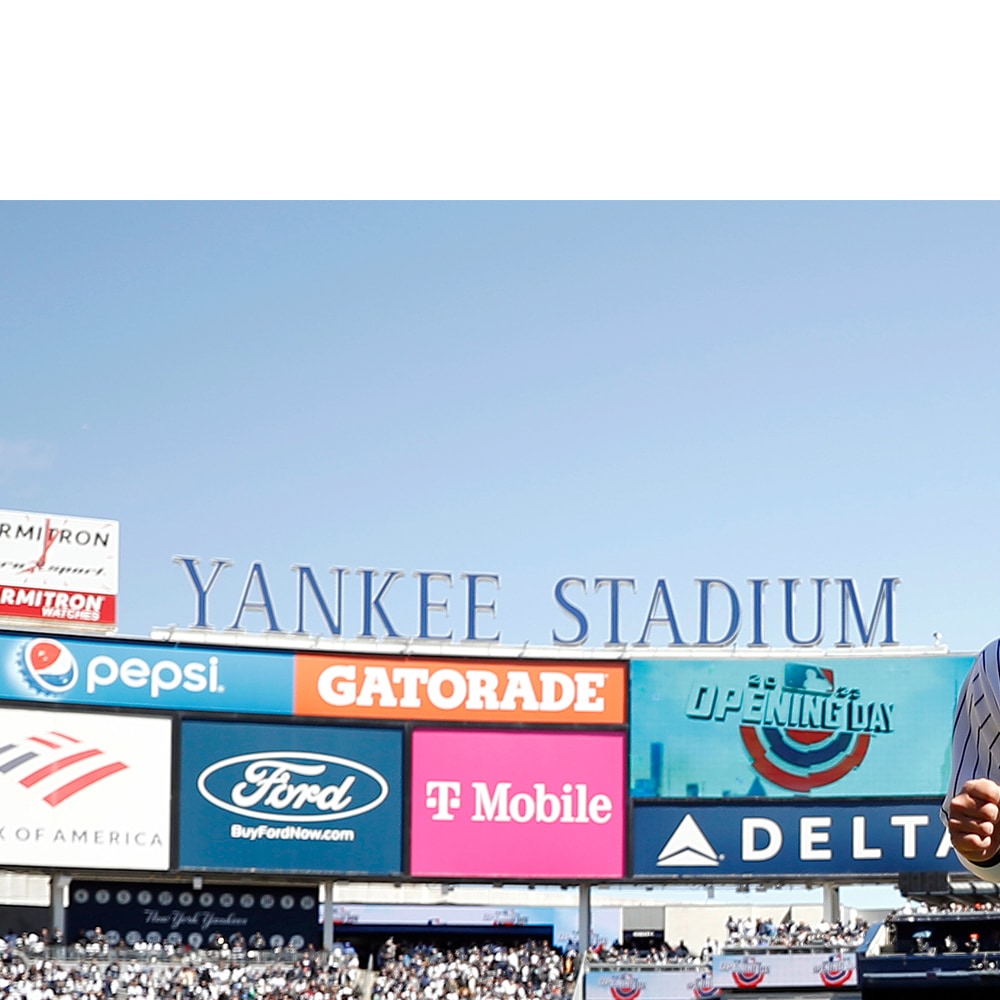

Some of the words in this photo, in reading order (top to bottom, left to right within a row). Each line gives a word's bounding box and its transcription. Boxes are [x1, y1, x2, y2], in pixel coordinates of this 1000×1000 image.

[42, 606, 100, 622] WATCHES
[172, 555, 501, 641] YANKEE
[551, 575, 902, 649] STADIUM
[87, 656, 222, 697] pepsi
[317, 665, 606, 713] GATORADE
[686, 682, 845, 729] OPENING
[847, 702, 895, 733] DAY
[231, 760, 356, 811] Ford
[426, 782, 461, 822] T
[471, 782, 613, 823] Mobile
[15, 827, 45, 841] OF
[53, 828, 163, 846] AMERICA
[230, 824, 355, 841] BuyFordNow.com
[742, 815, 955, 861] DELT
